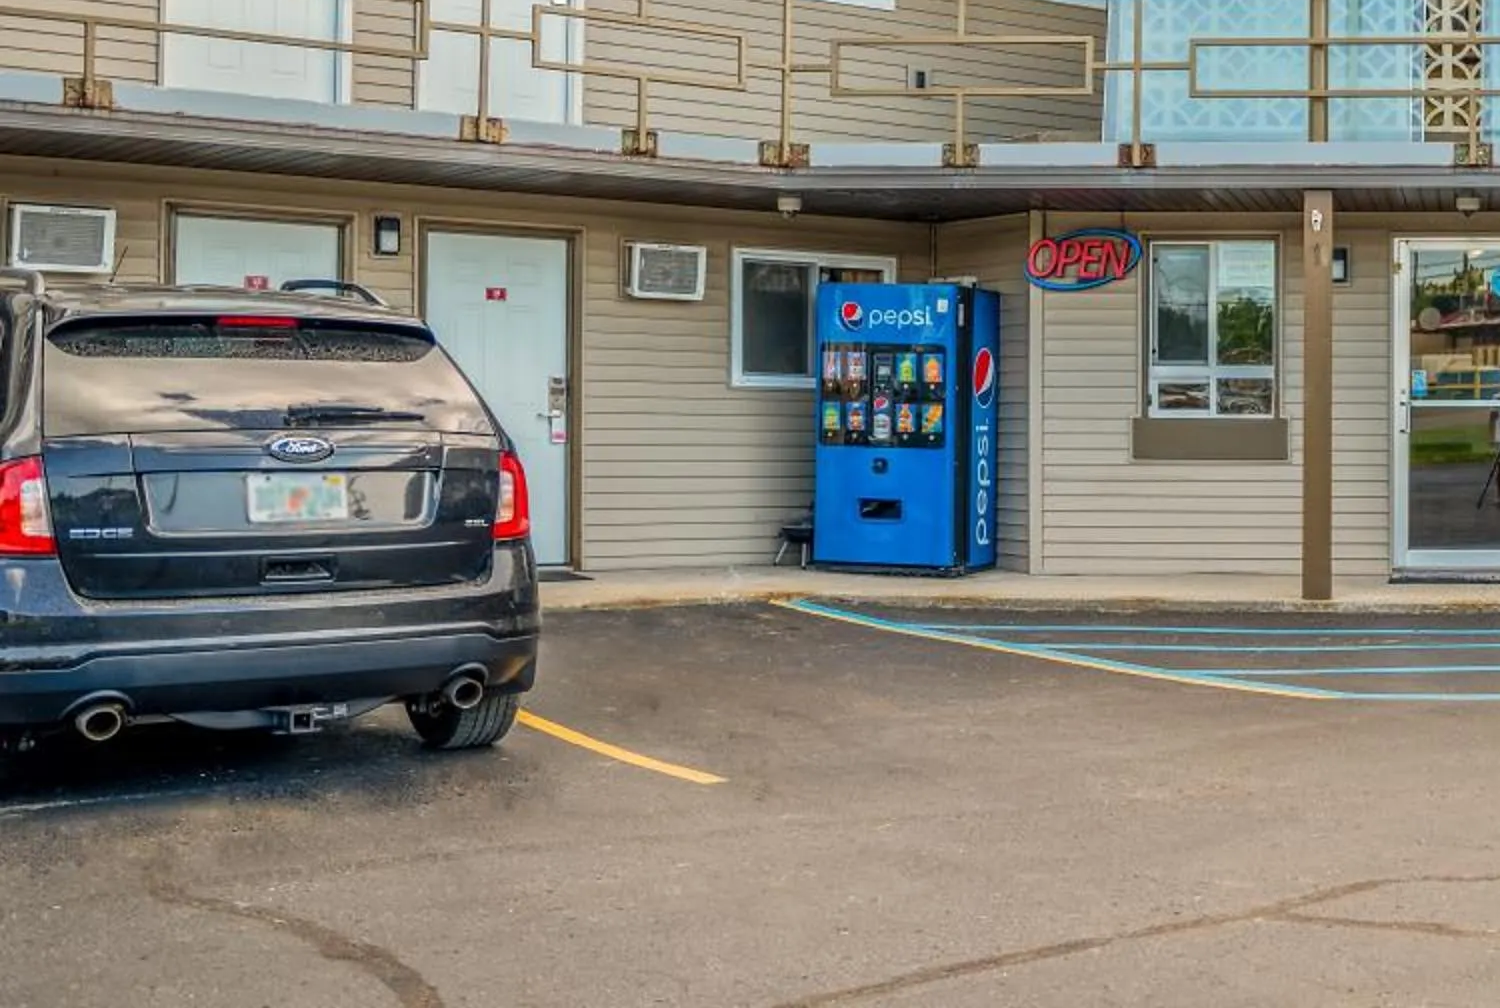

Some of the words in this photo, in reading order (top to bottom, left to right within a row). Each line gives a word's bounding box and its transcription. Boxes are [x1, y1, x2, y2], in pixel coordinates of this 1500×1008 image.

[1027, 238, 1131, 280] OPEN
[868, 304, 933, 329] pepsi
[975, 418, 991, 546] pepsi
